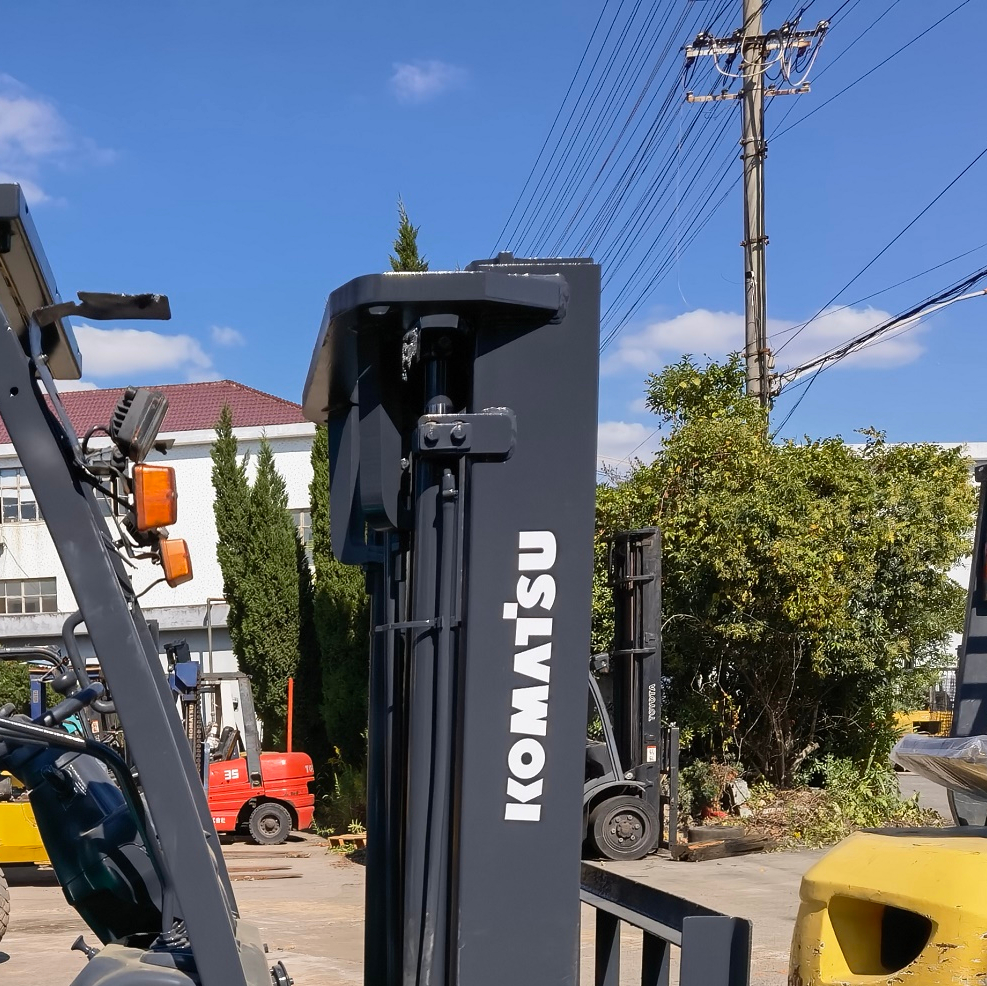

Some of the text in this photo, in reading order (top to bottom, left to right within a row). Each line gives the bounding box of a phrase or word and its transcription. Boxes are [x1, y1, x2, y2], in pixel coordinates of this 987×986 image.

[502, 529, 559, 823] KOMATSU
[648, 683, 656, 722] TOYOTA
[223, 768, 240, 781] 35
